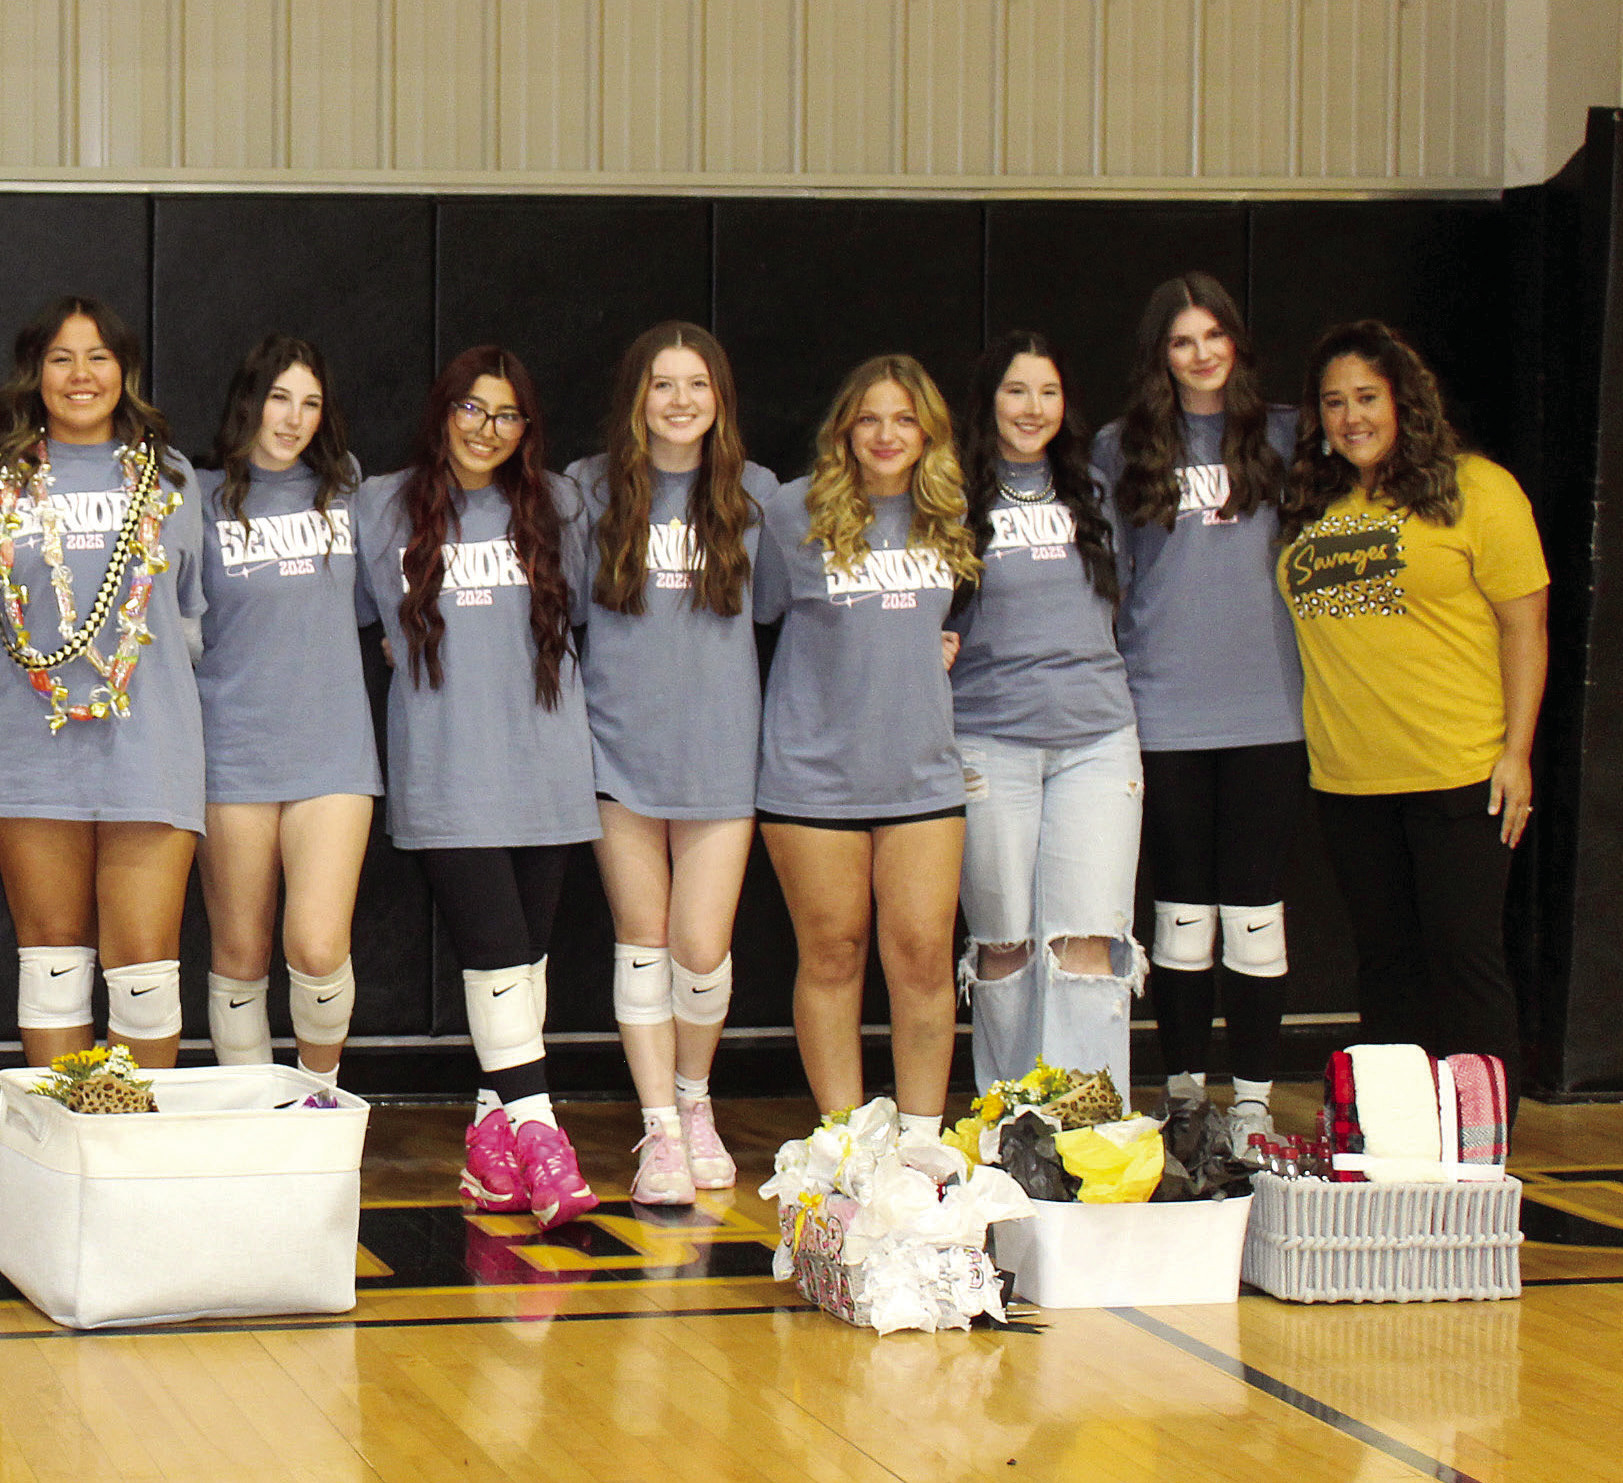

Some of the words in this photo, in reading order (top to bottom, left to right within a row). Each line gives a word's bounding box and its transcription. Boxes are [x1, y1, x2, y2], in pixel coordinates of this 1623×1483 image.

[988, 503, 1078, 549] ENIO
[65, 533, 106, 550] 2025
[216, 508, 354, 567] SENIORS
[1030, 545, 1068, 562] 2025
[278, 557, 316, 577] 2025
[399, 540, 529, 594] NIOR
[1294, 543, 1390, 586] Savages
[455, 588, 494, 607] 2025
[880, 591, 918, 610] 2025
